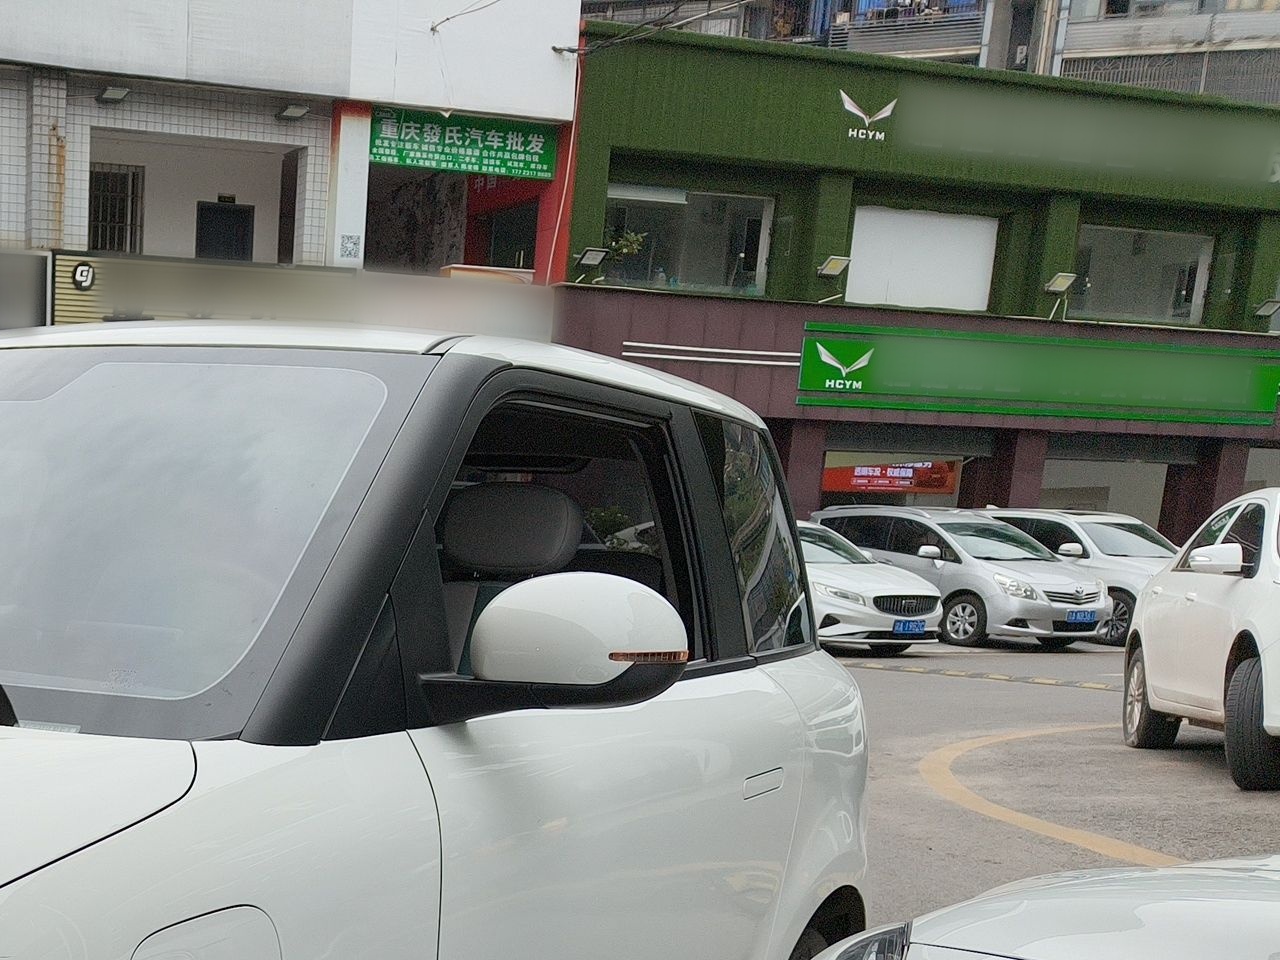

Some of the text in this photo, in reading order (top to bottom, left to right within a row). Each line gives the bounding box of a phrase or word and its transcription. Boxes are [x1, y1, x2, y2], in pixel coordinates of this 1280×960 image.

[380, 118, 545, 154] 重庆發氏汽车批发
[848, 128, 885, 141] HCYM
[825, 379, 863, 389] HCYM
